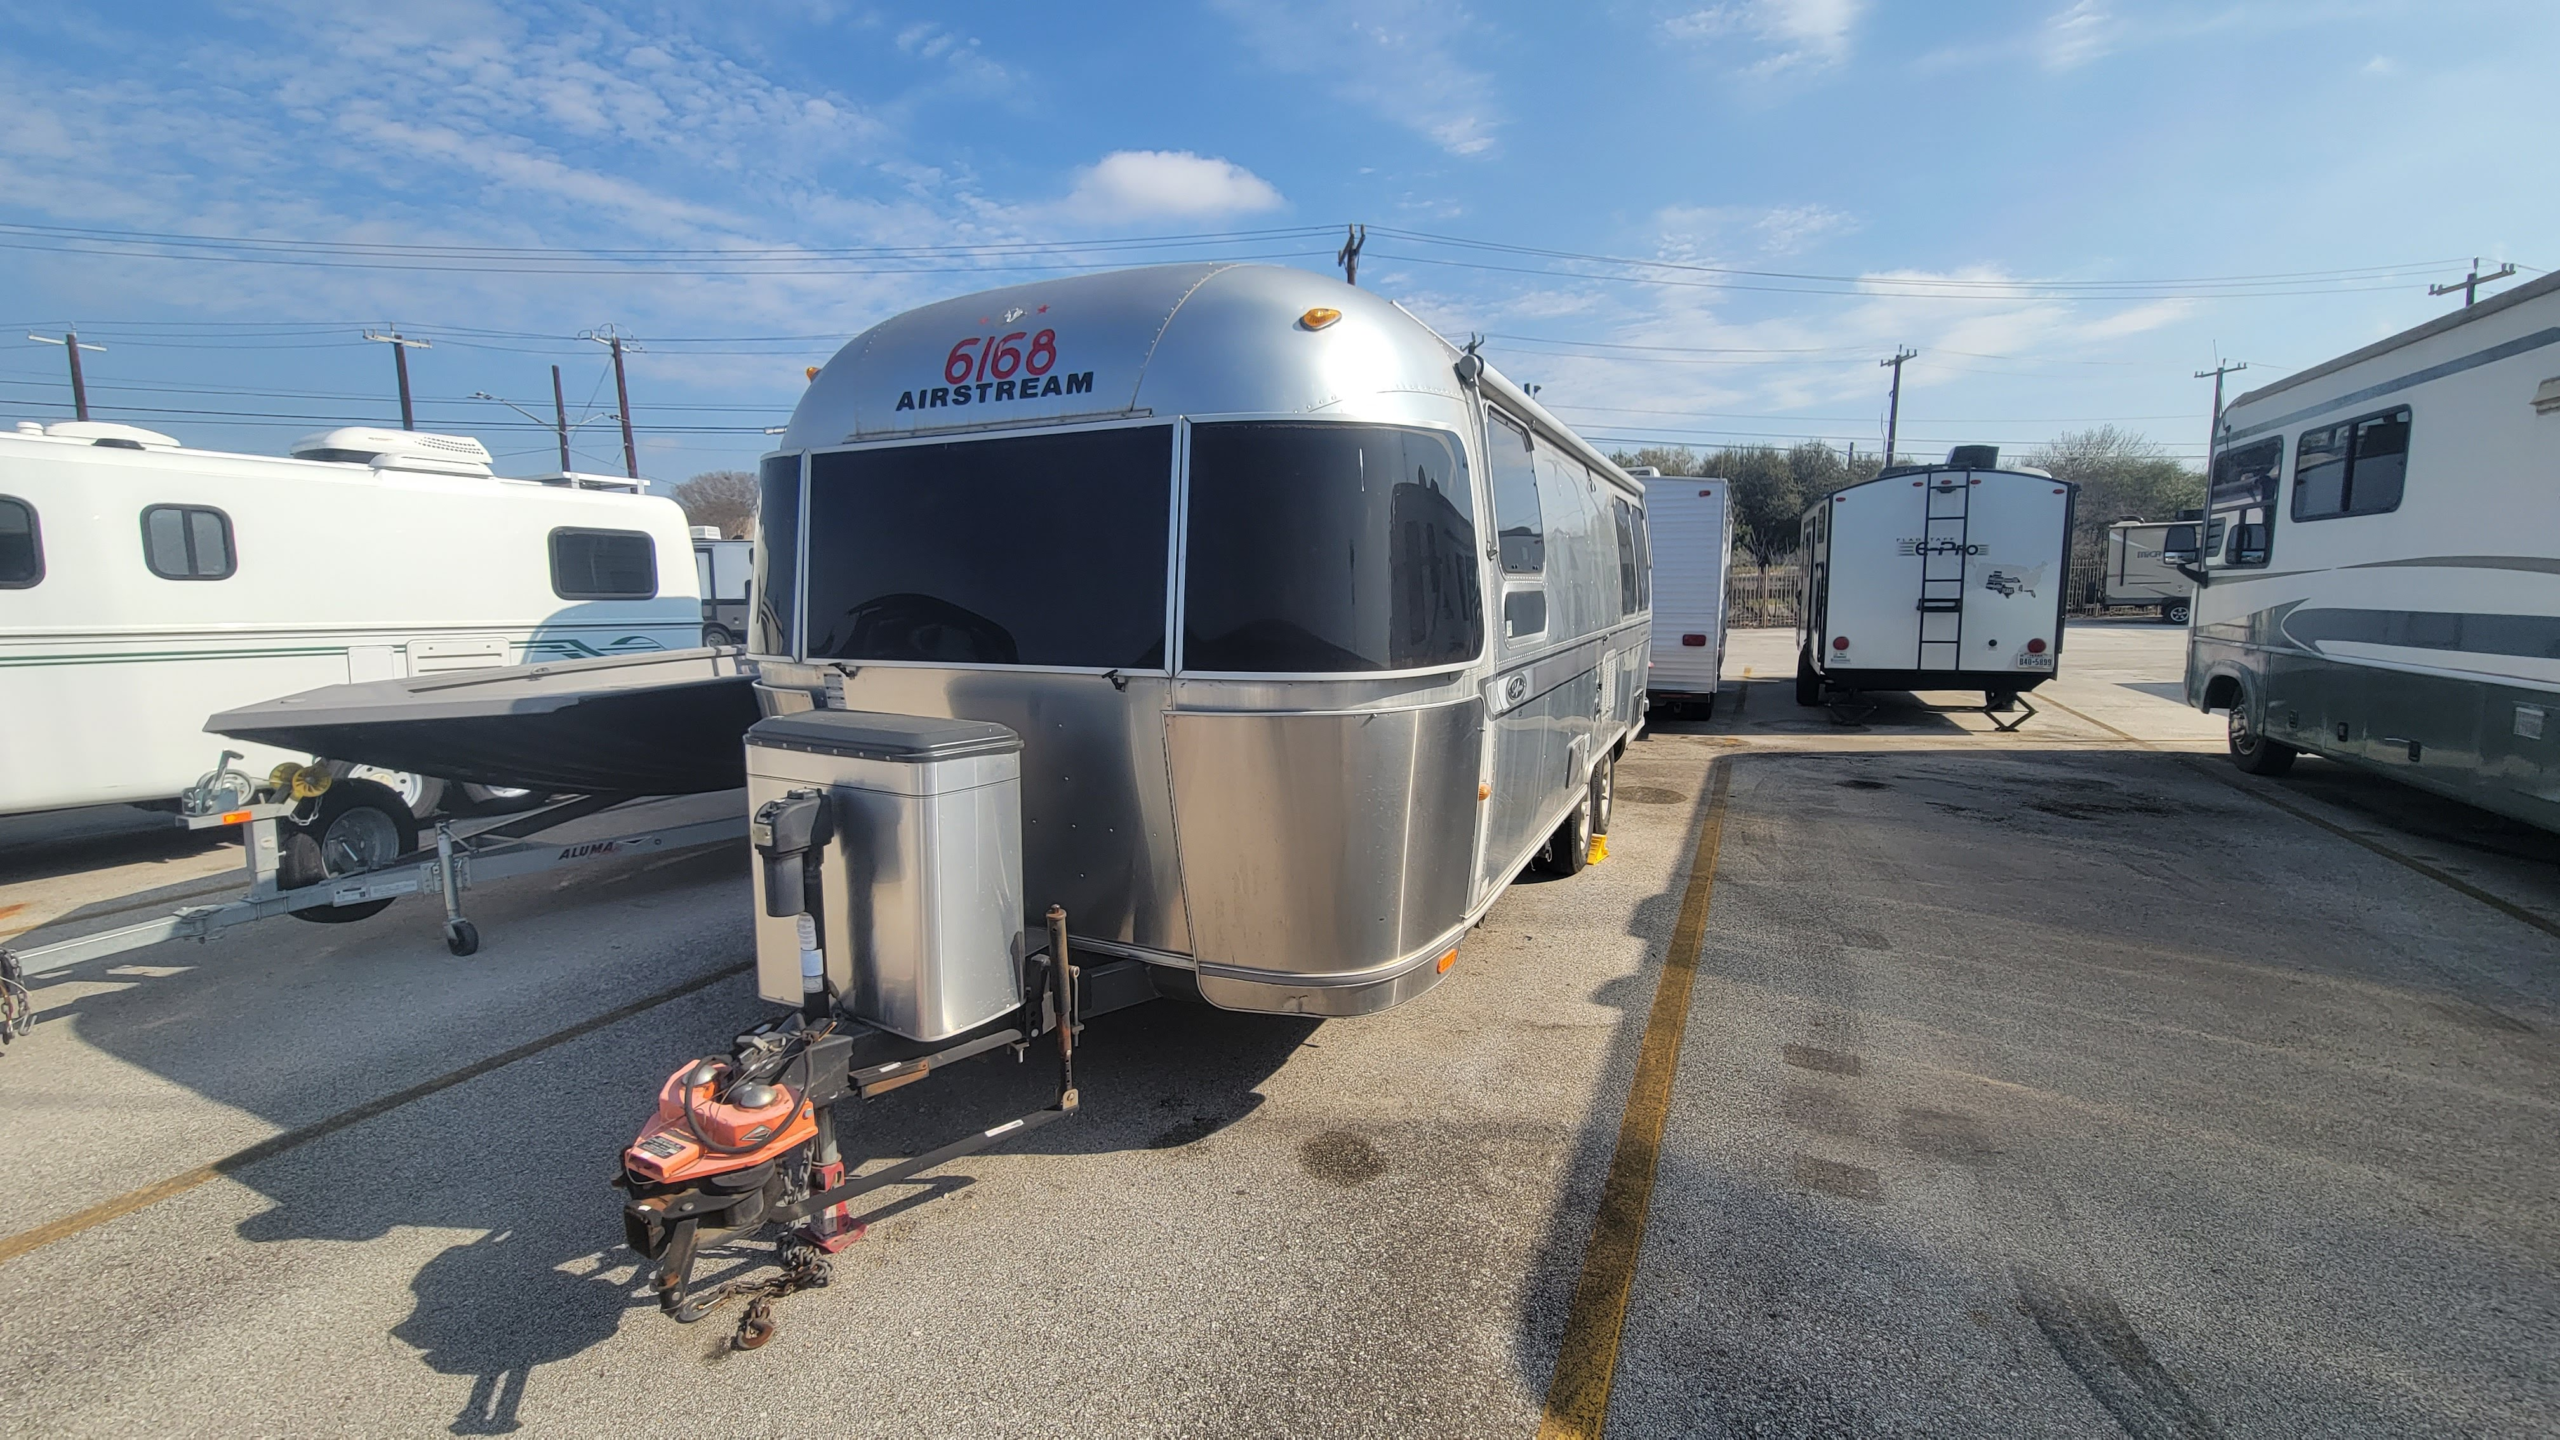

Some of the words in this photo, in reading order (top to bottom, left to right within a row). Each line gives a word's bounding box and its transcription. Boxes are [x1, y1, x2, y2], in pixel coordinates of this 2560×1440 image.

[944, 328, 1057, 385] 6168
[895, 371, 1094, 412] AIRSTREAM
[558, 841, 614, 860] ALUMA
